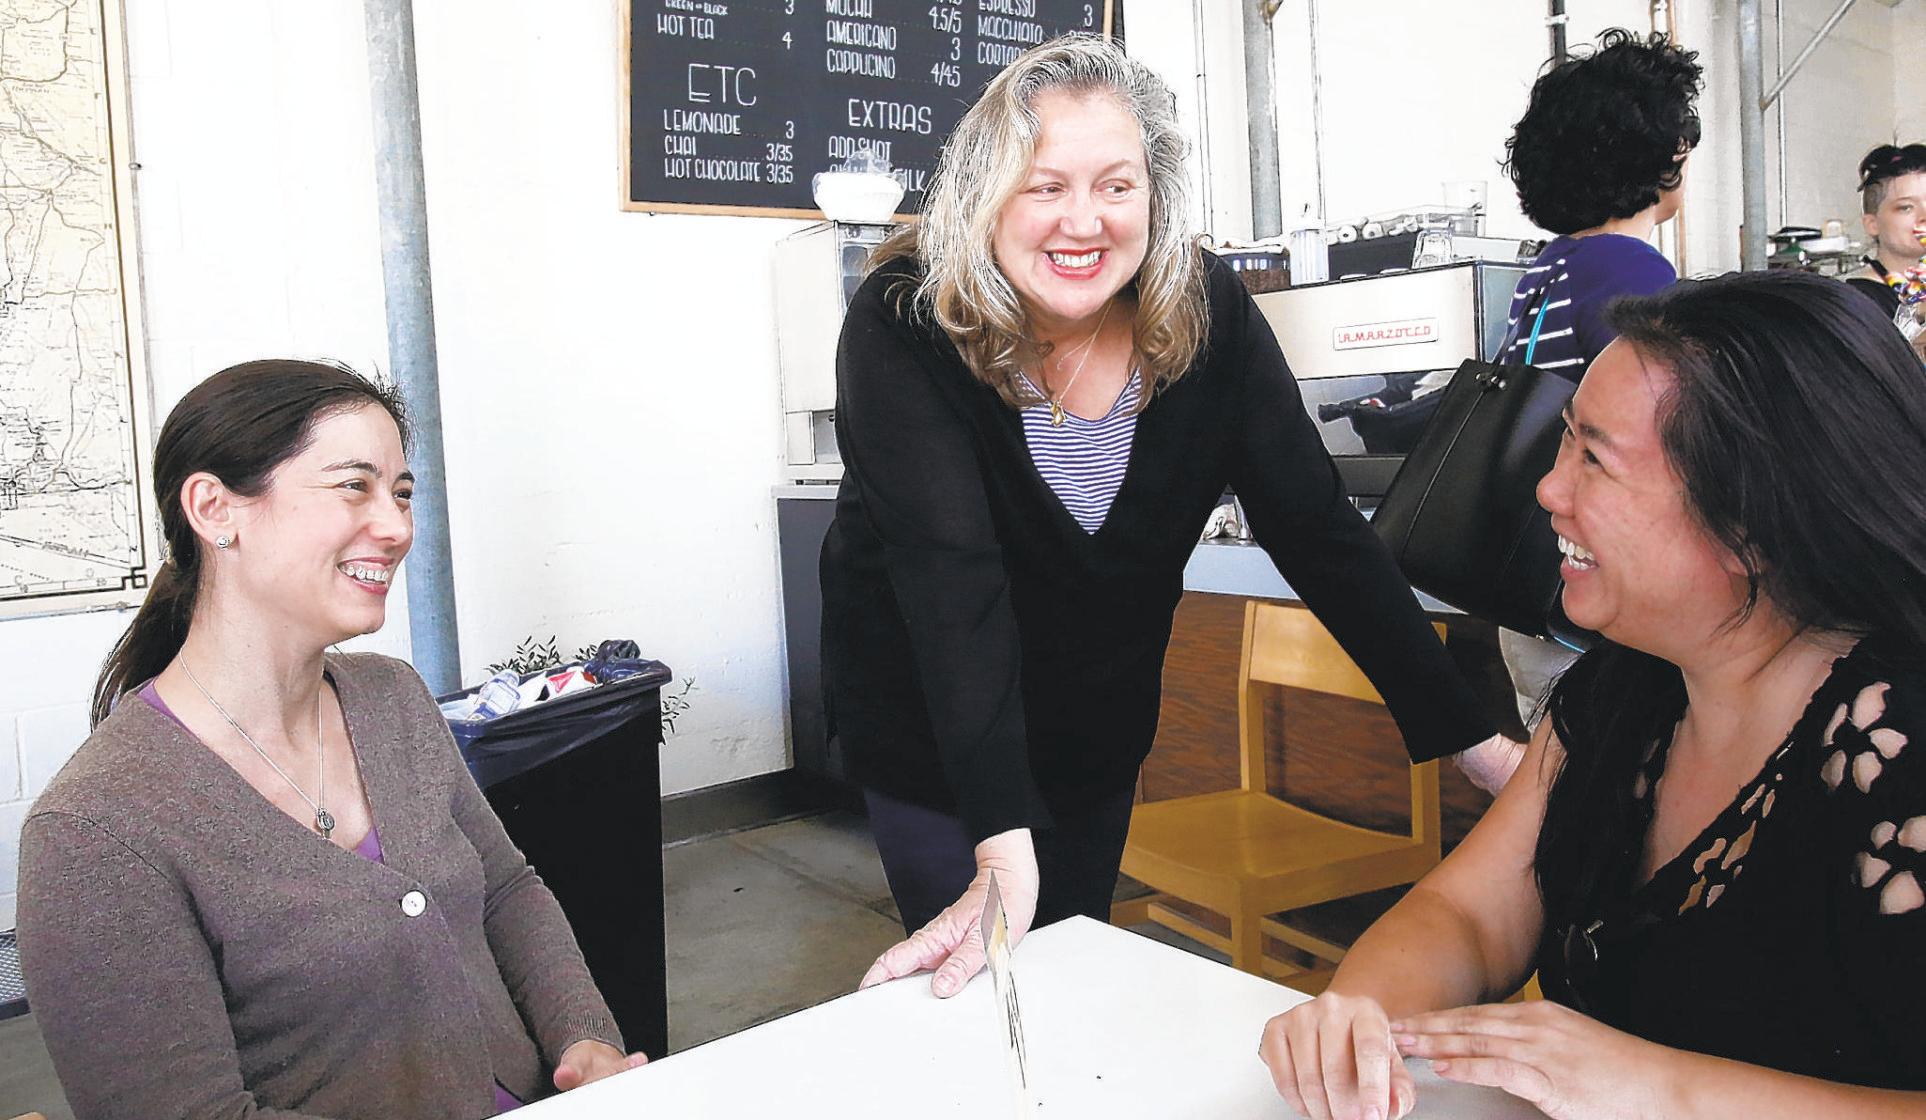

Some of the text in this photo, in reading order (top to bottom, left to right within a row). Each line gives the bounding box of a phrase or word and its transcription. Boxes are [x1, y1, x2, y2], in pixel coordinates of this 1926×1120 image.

[785, 0, 794, 15] 3
[825, 0, 872, 19] MOCHA
[1083, 4, 1093, 27] 3
[657, 13, 792, 50] HOT TEA 4
[826, 20, 961, 61] AMERICANO 3
[826, 48, 896, 79] CAPPUCINO
[977, 41, 1027, 67] CORTA
[688, 62, 757, 106] ETC
[663, 108, 795, 139] LEMONADE 3
[848, 98, 932, 135] EXTRAS
[664, 134, 697, 156] CHAI
[828, 135, 856, 159] ADD
[664, 157, 692, 179] HOT
[694, 158, 761, 182] CHOCOLATE
